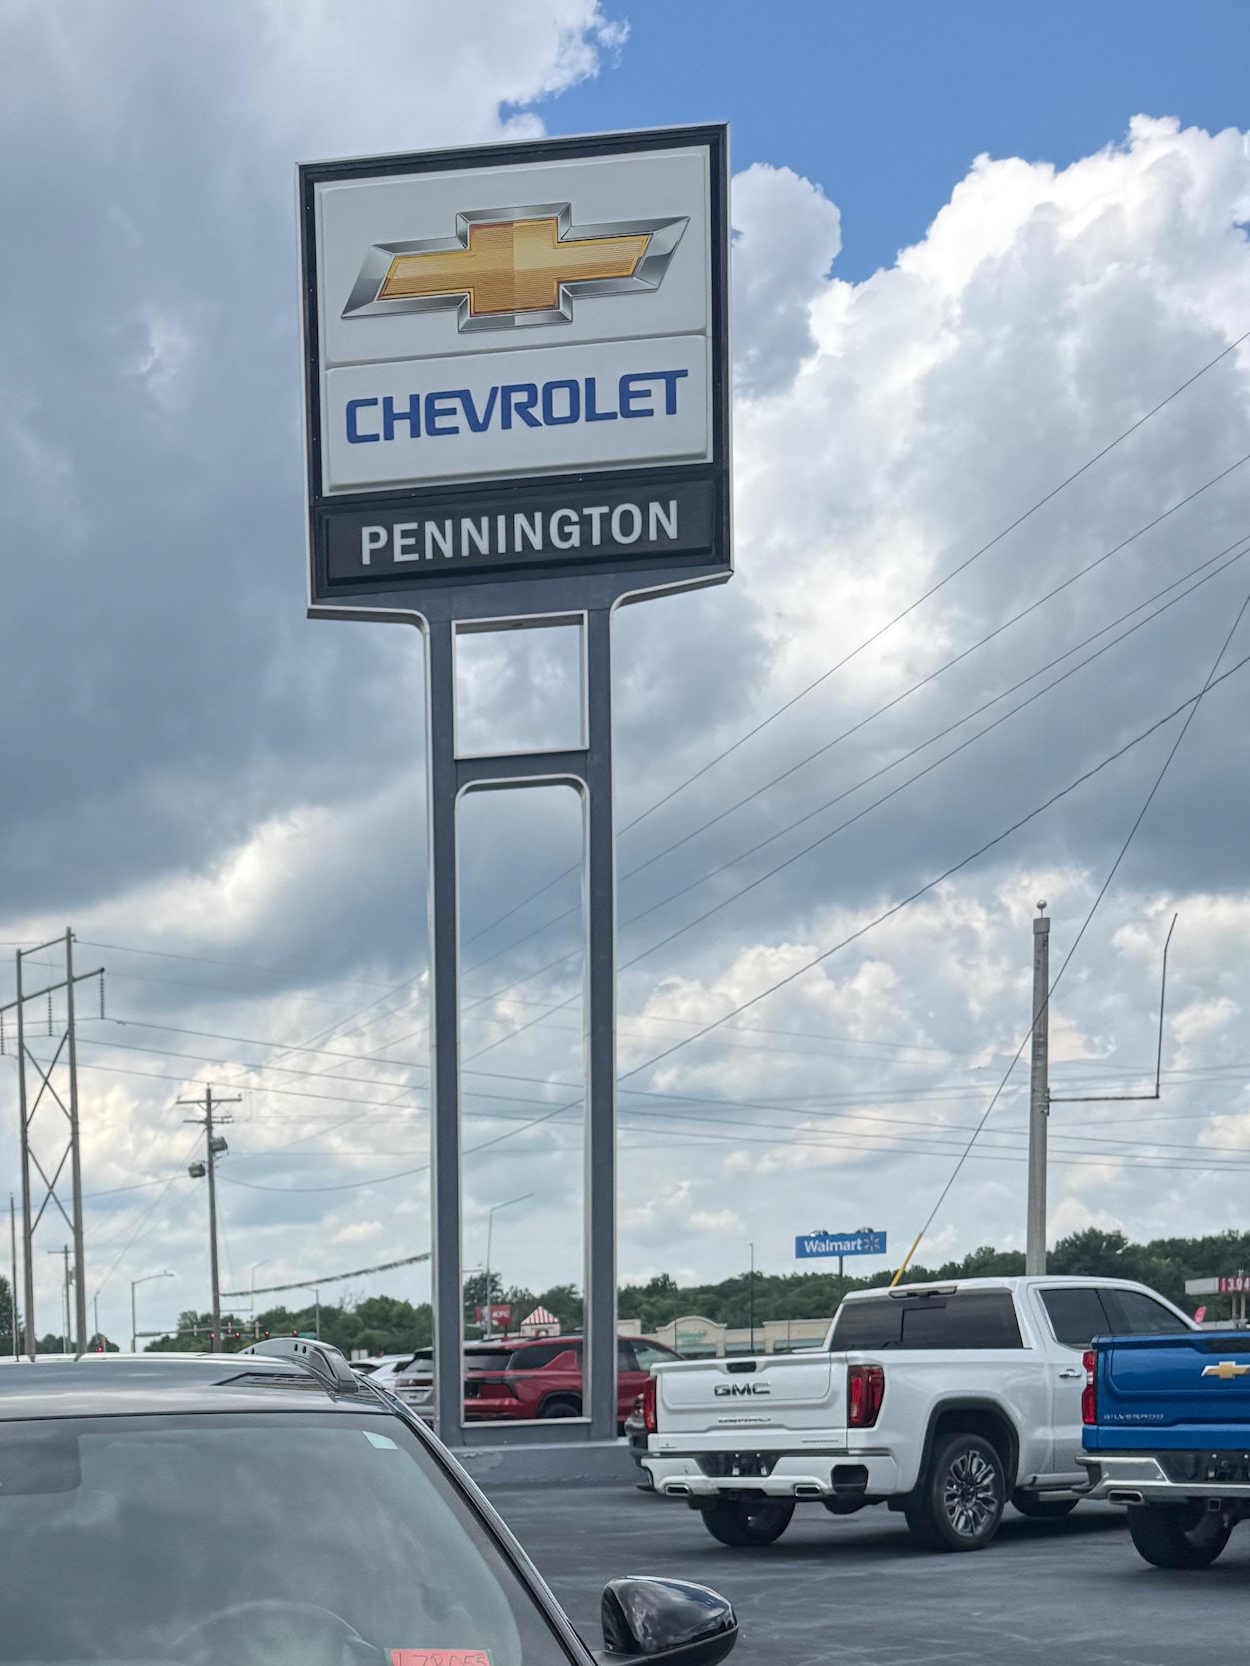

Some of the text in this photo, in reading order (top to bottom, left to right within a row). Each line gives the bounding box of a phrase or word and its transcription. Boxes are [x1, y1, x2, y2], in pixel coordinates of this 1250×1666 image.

[345, 369, 689, 443] CHEVROLET
[360, 500, 679, 565] PENNINGTON
[804, 1238, 862, 1253] Walmart
[714, 1382, 771, 1397] GMC
